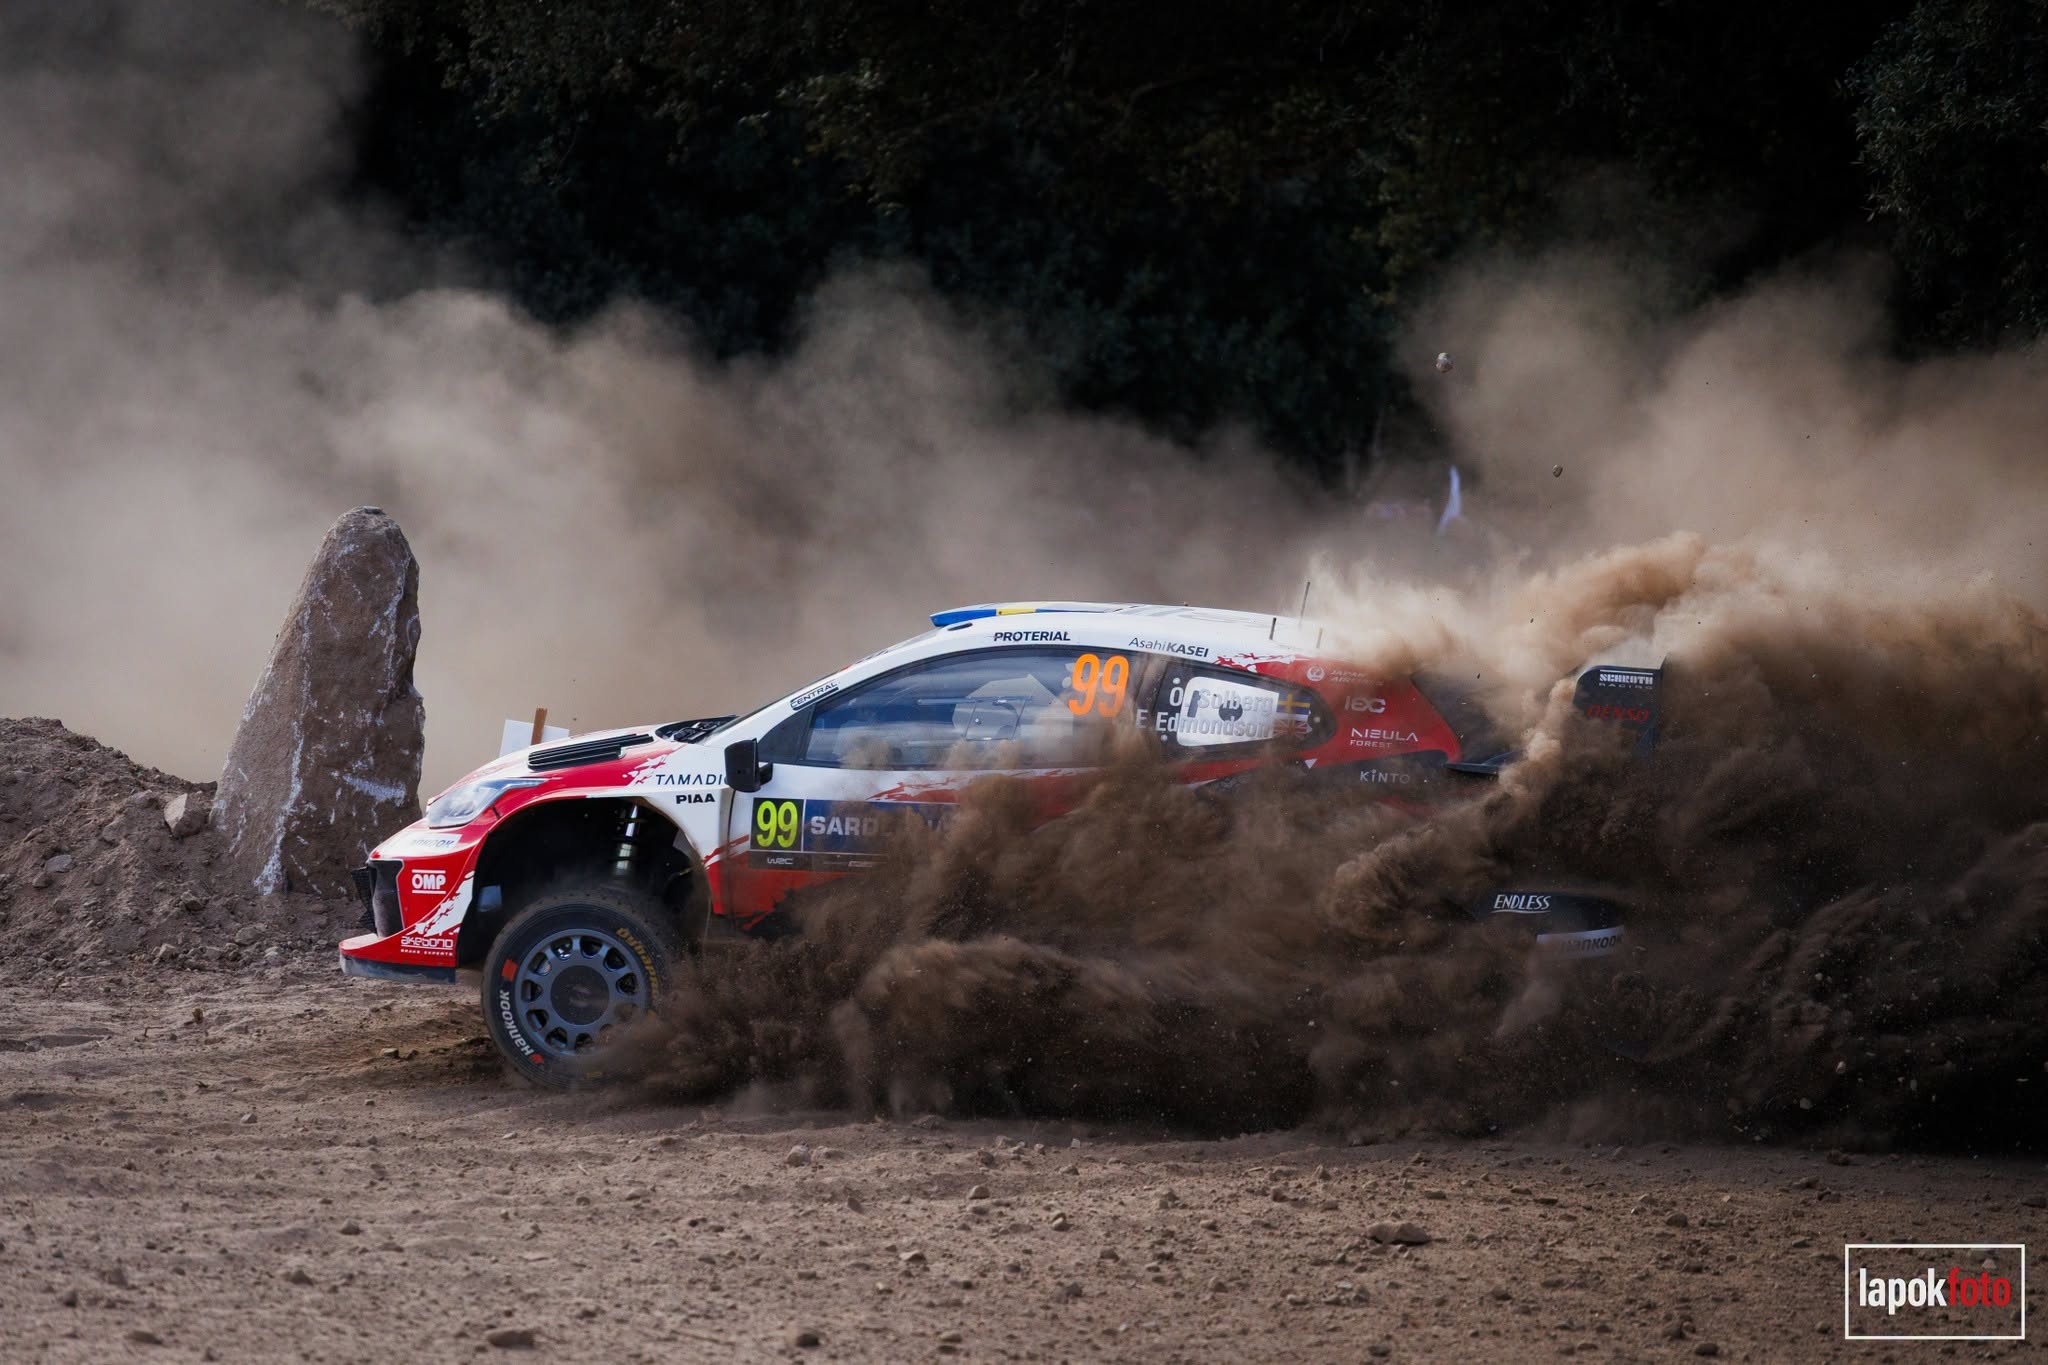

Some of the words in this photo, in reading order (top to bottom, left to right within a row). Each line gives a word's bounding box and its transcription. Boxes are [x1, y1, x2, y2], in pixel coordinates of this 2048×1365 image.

[994, 631, 1071, 642] PROTERIAL
[1068, 653, 1130, 718] 99
[1600, 673, 1653, 684] SCHROTH
[1198, 687, 1275, 714] Solberg
[655, 774, 728, 786] TAMADI
[675, 793, 716, 805] PIAA
[756, 800, 799, 848] 99
[411, 873, 446, 890] OMP
[1493, 894, 1552, 910] ENDLESS
